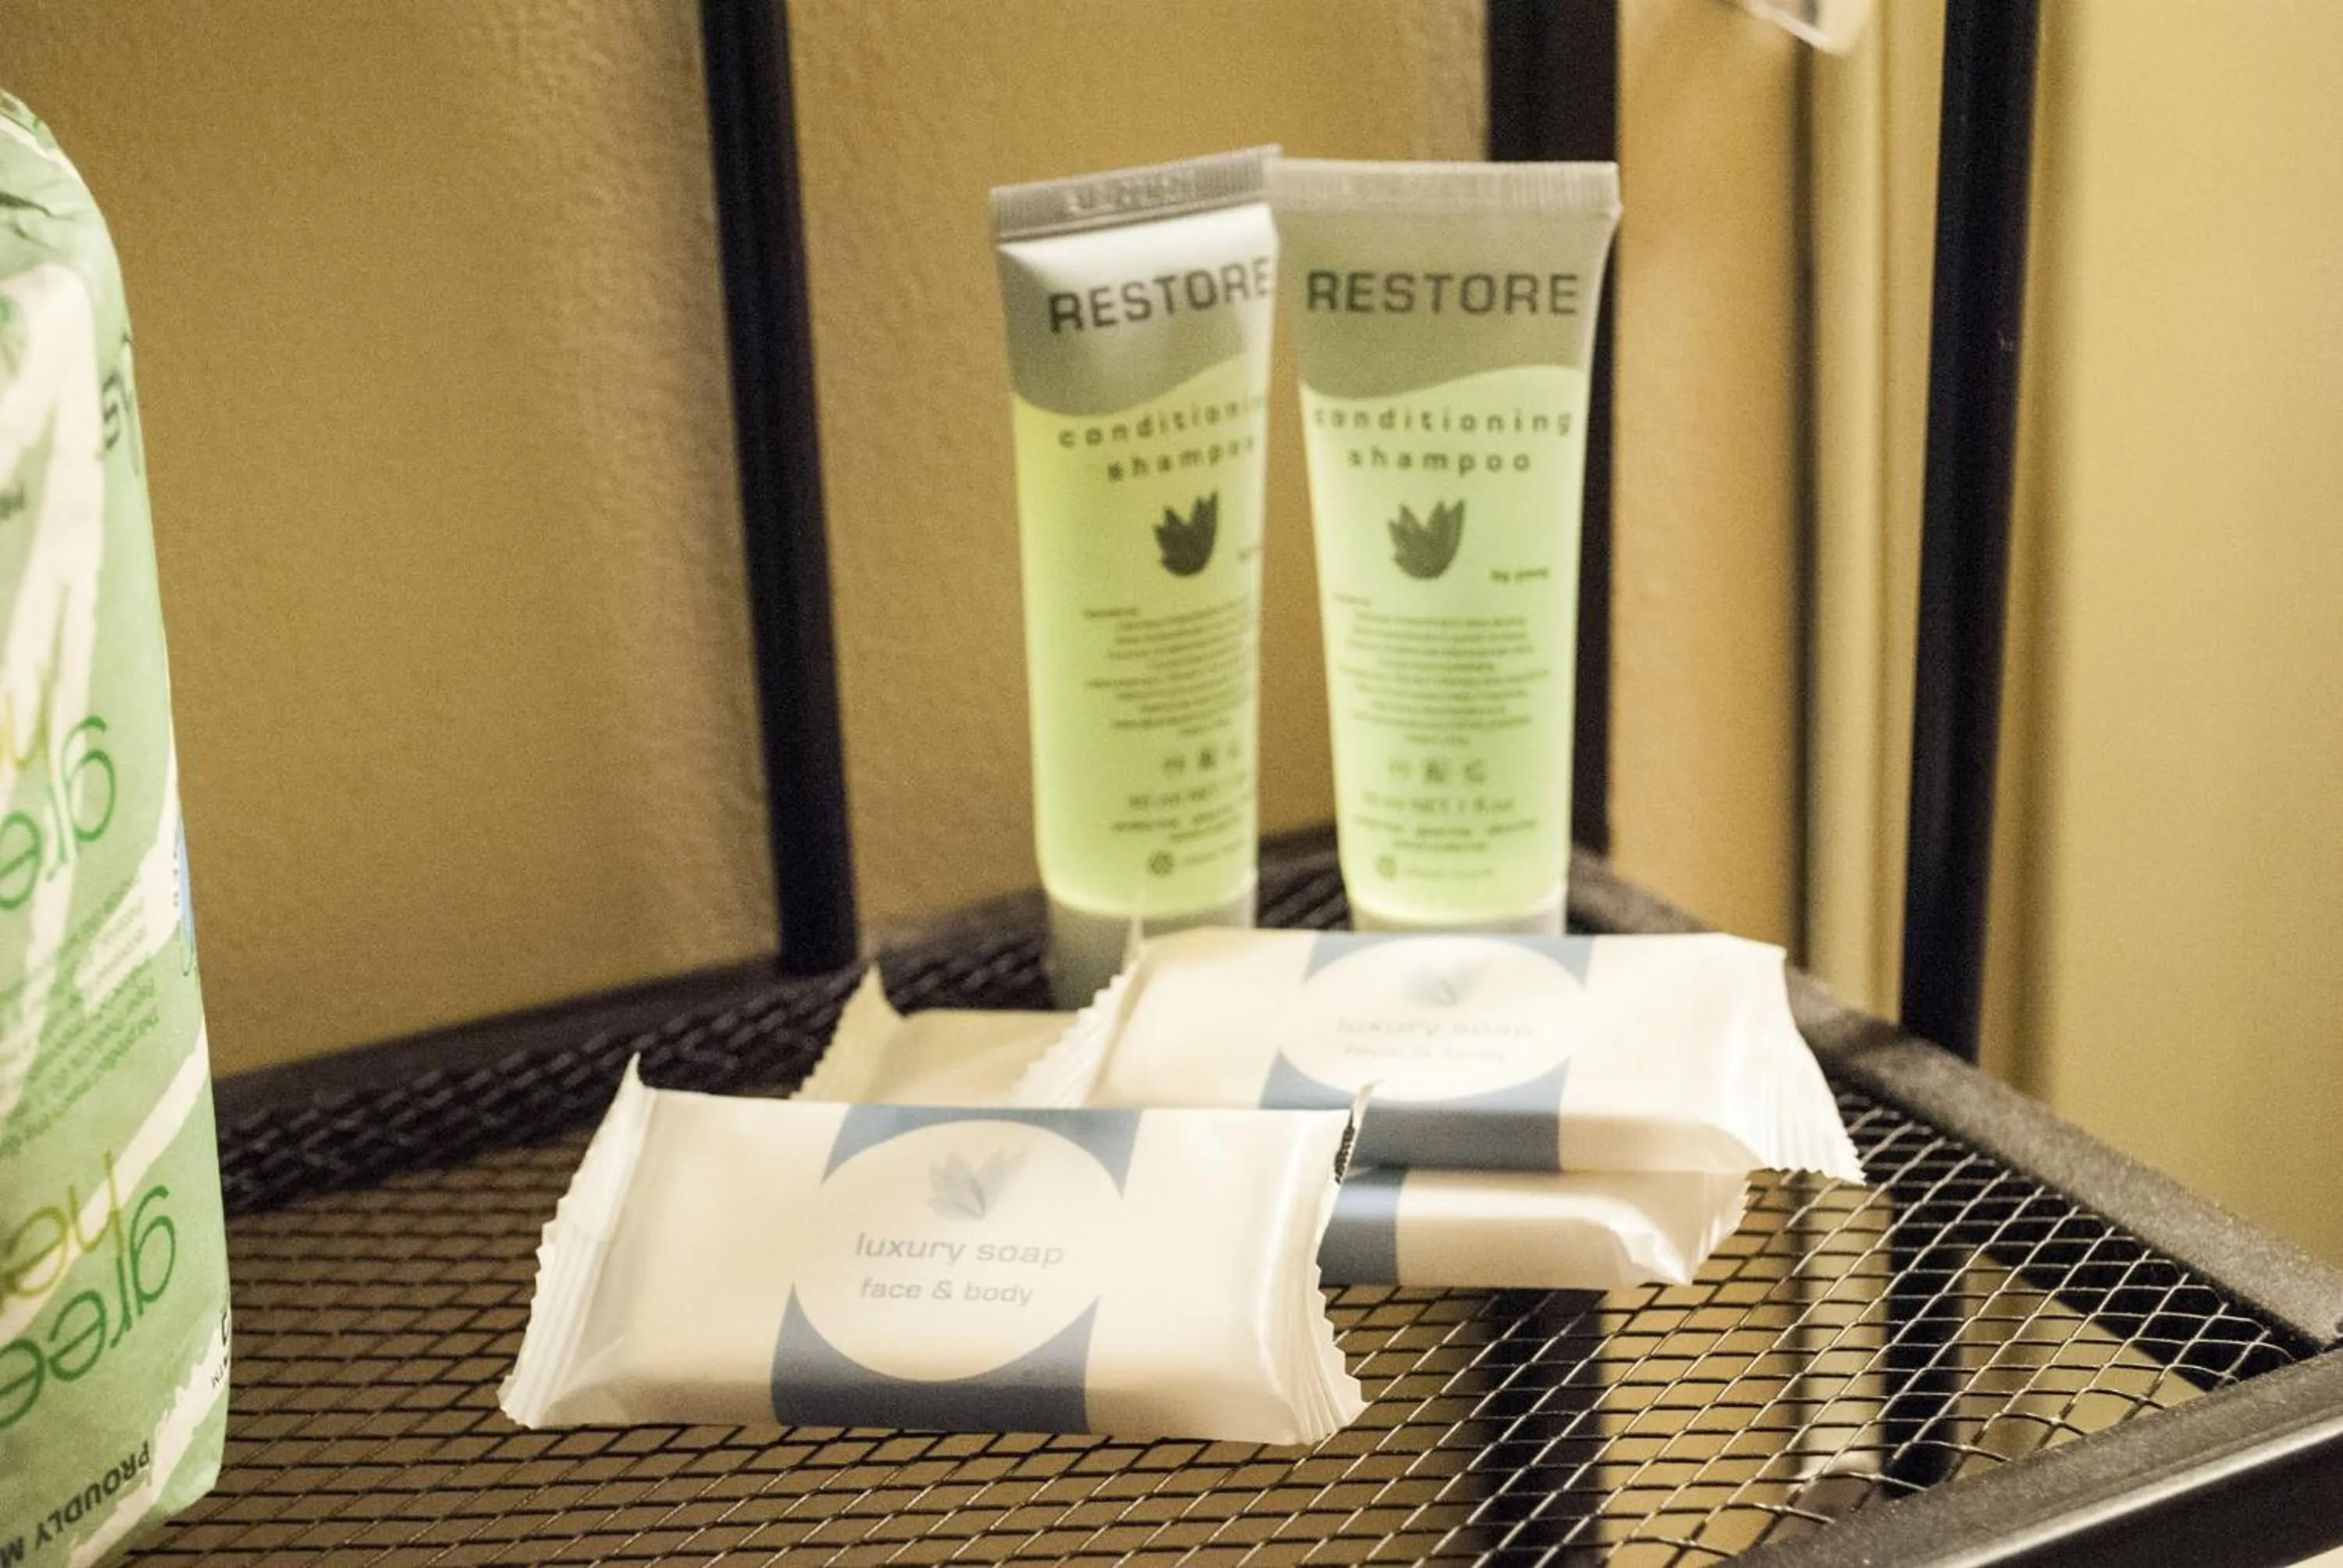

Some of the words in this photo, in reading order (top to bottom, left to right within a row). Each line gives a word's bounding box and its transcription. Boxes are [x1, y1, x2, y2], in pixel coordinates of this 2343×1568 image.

[1047, 256, 1273, 333] RESTORE
[1307, 271, 1579, 315] RESTORE
[1314, 406, 1572, 437] conditioning
[1348, 446, 1531, 478] shampoo
[854, 1231, 965, 1266] luxury
[975, 1244, 1065, 1270] soap
[859, 1277, 922, 1299] face
[930, 1278, 954, 1299] &
[963, 1281, 1033, 1307] body
[35, 1441, 149, 1550] PROUDLY
